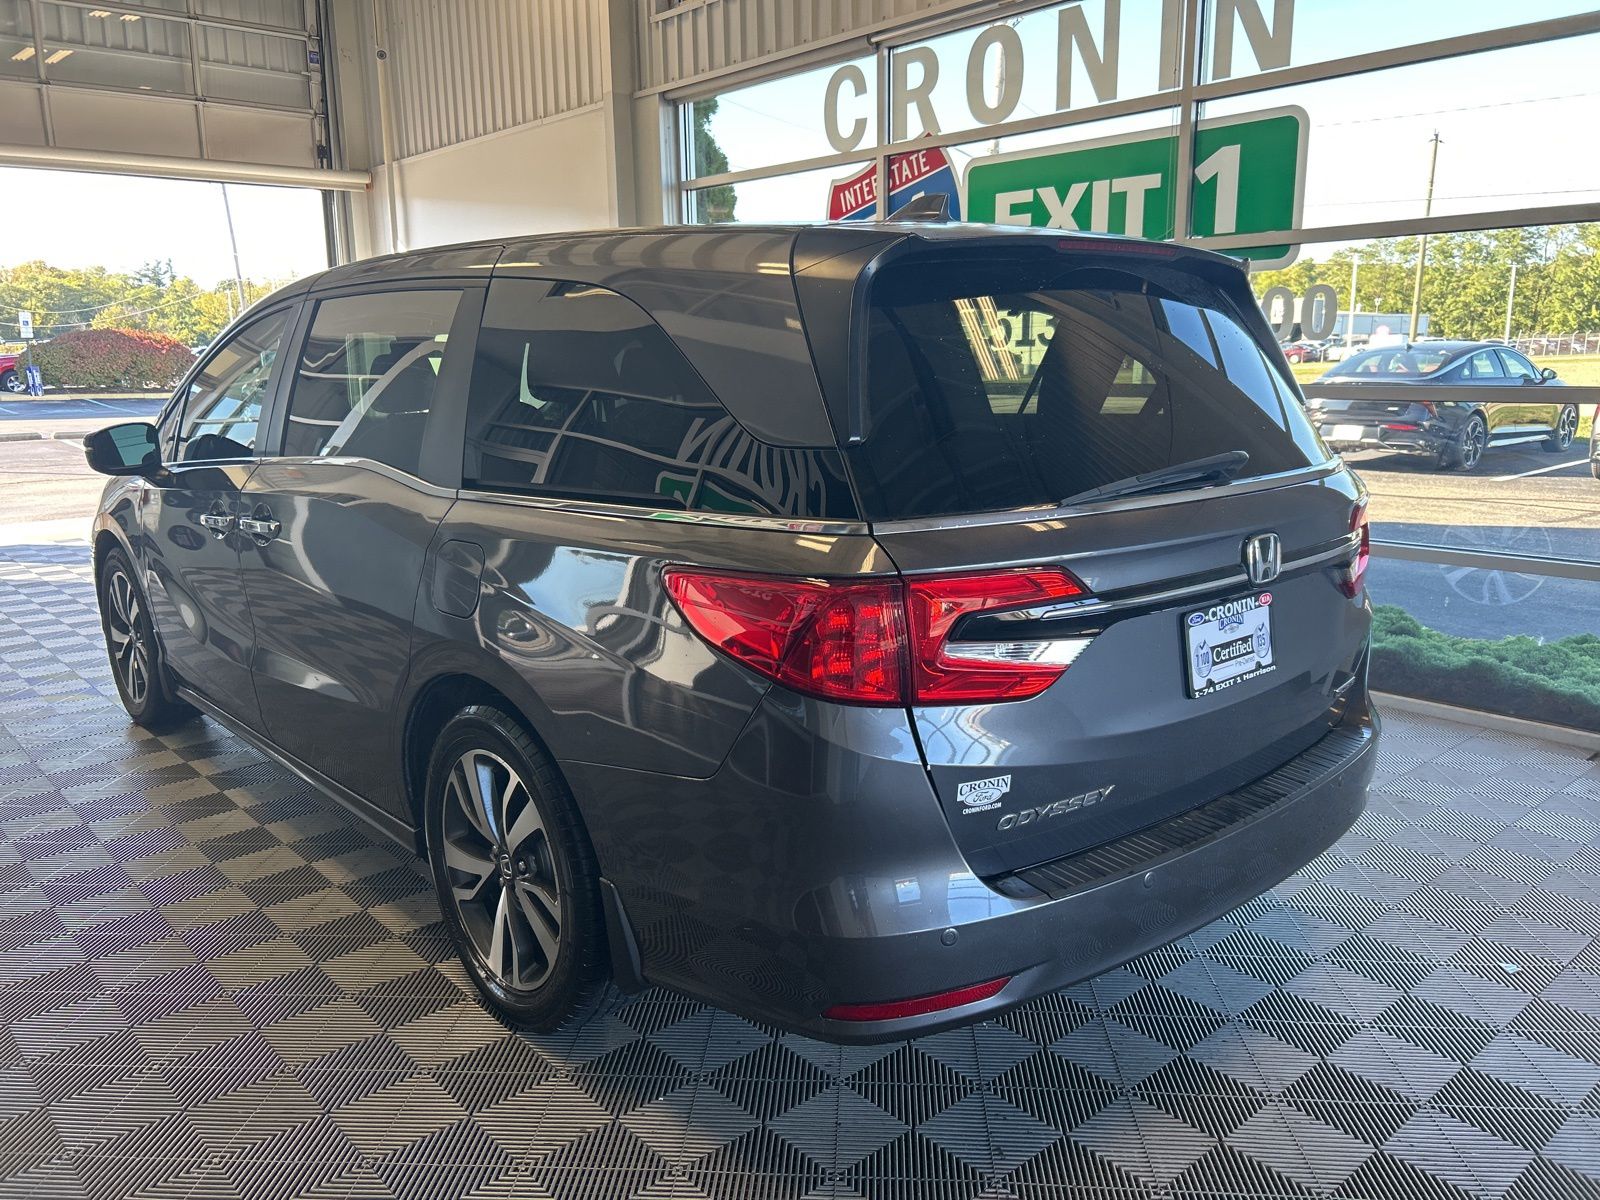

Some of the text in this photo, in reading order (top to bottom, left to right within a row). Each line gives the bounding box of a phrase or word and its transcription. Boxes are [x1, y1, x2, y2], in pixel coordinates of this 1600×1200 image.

[824, 0, 1295, 153] CRONIN
[840, 150, 930, 213] INTETATE
[995, 144, 1241, 239] EXIT 1
[1208, 596, 1256, 621] CRONIN
[1260, 594, 1271, 604] KIA
[1213, 637, 1253, 662] Certified
[1195, 665, 1276, 699] I-74 EXIT 1 Harrison
[959, 777, 1010, 796] CRONIN
[973, 791, 994, 803] Ford
[996, 784, 1116, 831] ODYSSEY
